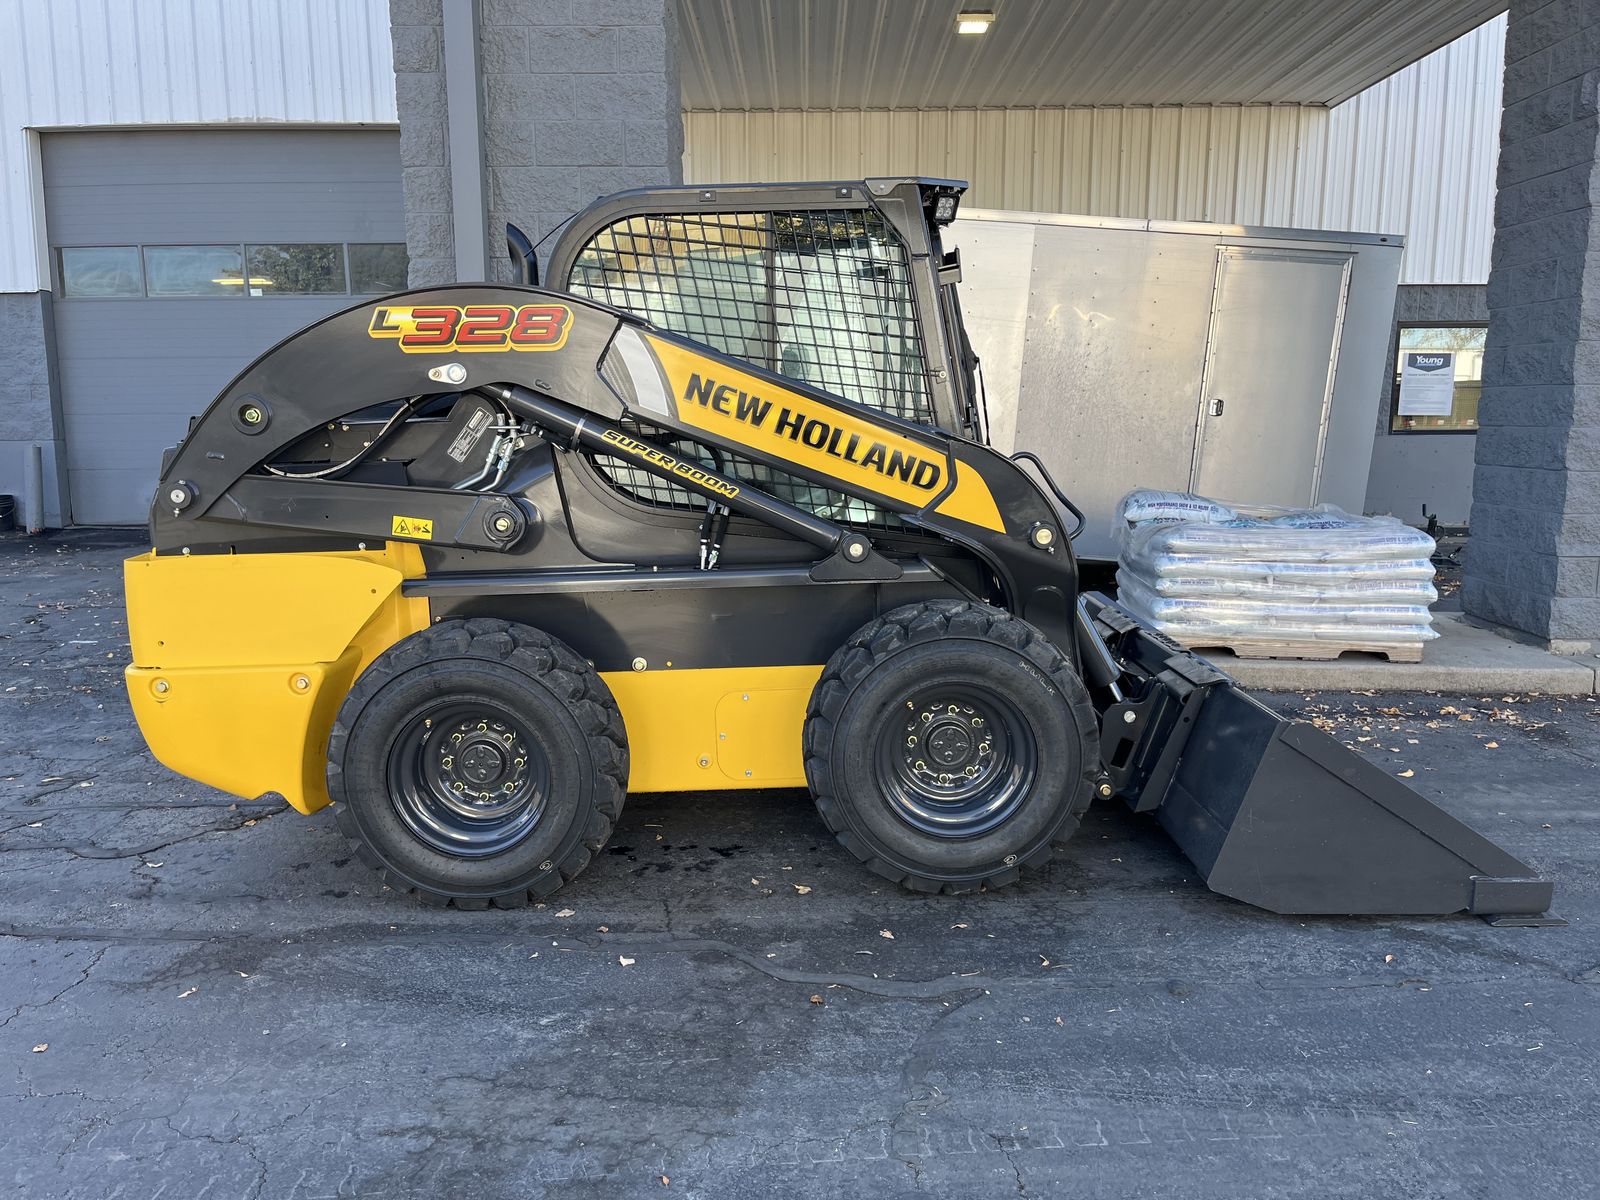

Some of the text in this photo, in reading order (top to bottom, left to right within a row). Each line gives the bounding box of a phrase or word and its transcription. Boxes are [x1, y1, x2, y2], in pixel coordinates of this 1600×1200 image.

[369, 305, 573, 352] L328
[1416, 356, 1444, 366] Young
[683, 373, 942, 491] NEW HOLLAND
[601, 429, 740, 499] SUPER BOOM
